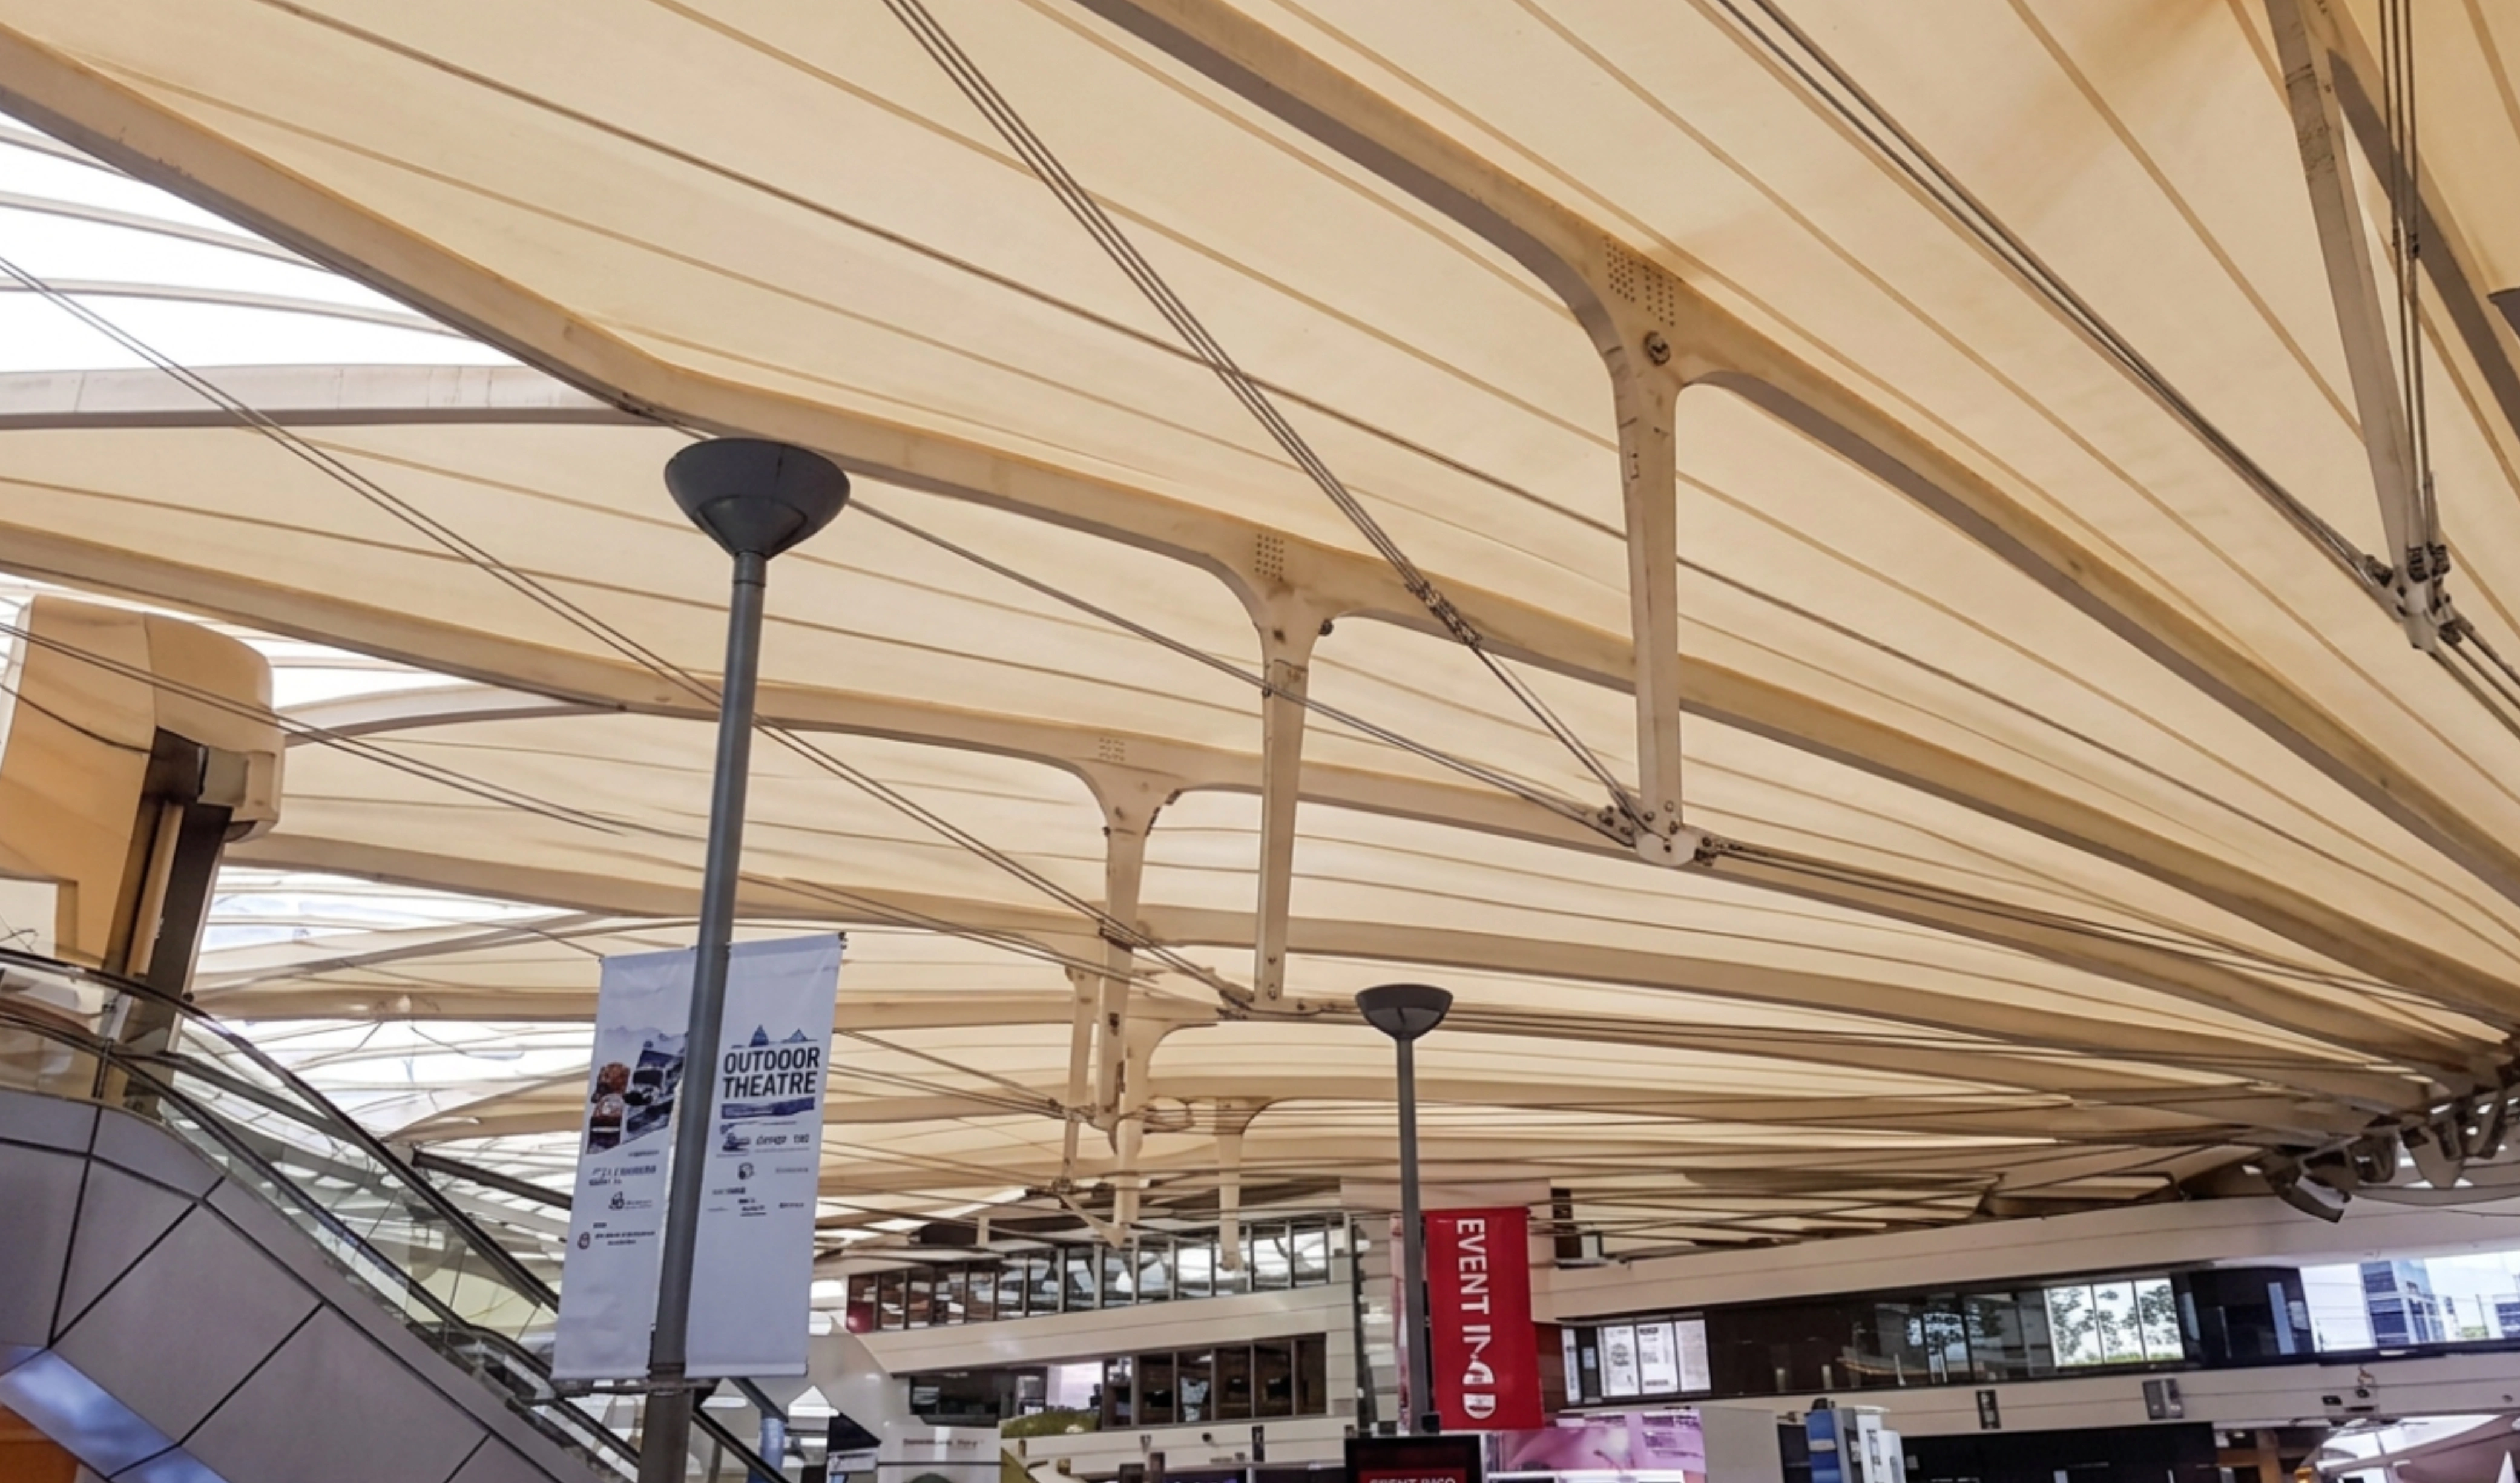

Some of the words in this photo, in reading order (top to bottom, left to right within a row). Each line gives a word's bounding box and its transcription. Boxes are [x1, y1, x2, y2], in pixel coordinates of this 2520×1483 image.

[724, 1047, 820, 1074] OUTDOOR
[723, 1071, 817, 1099] THEATRE
[1456, 1218, 1490, 1315] EVENT
